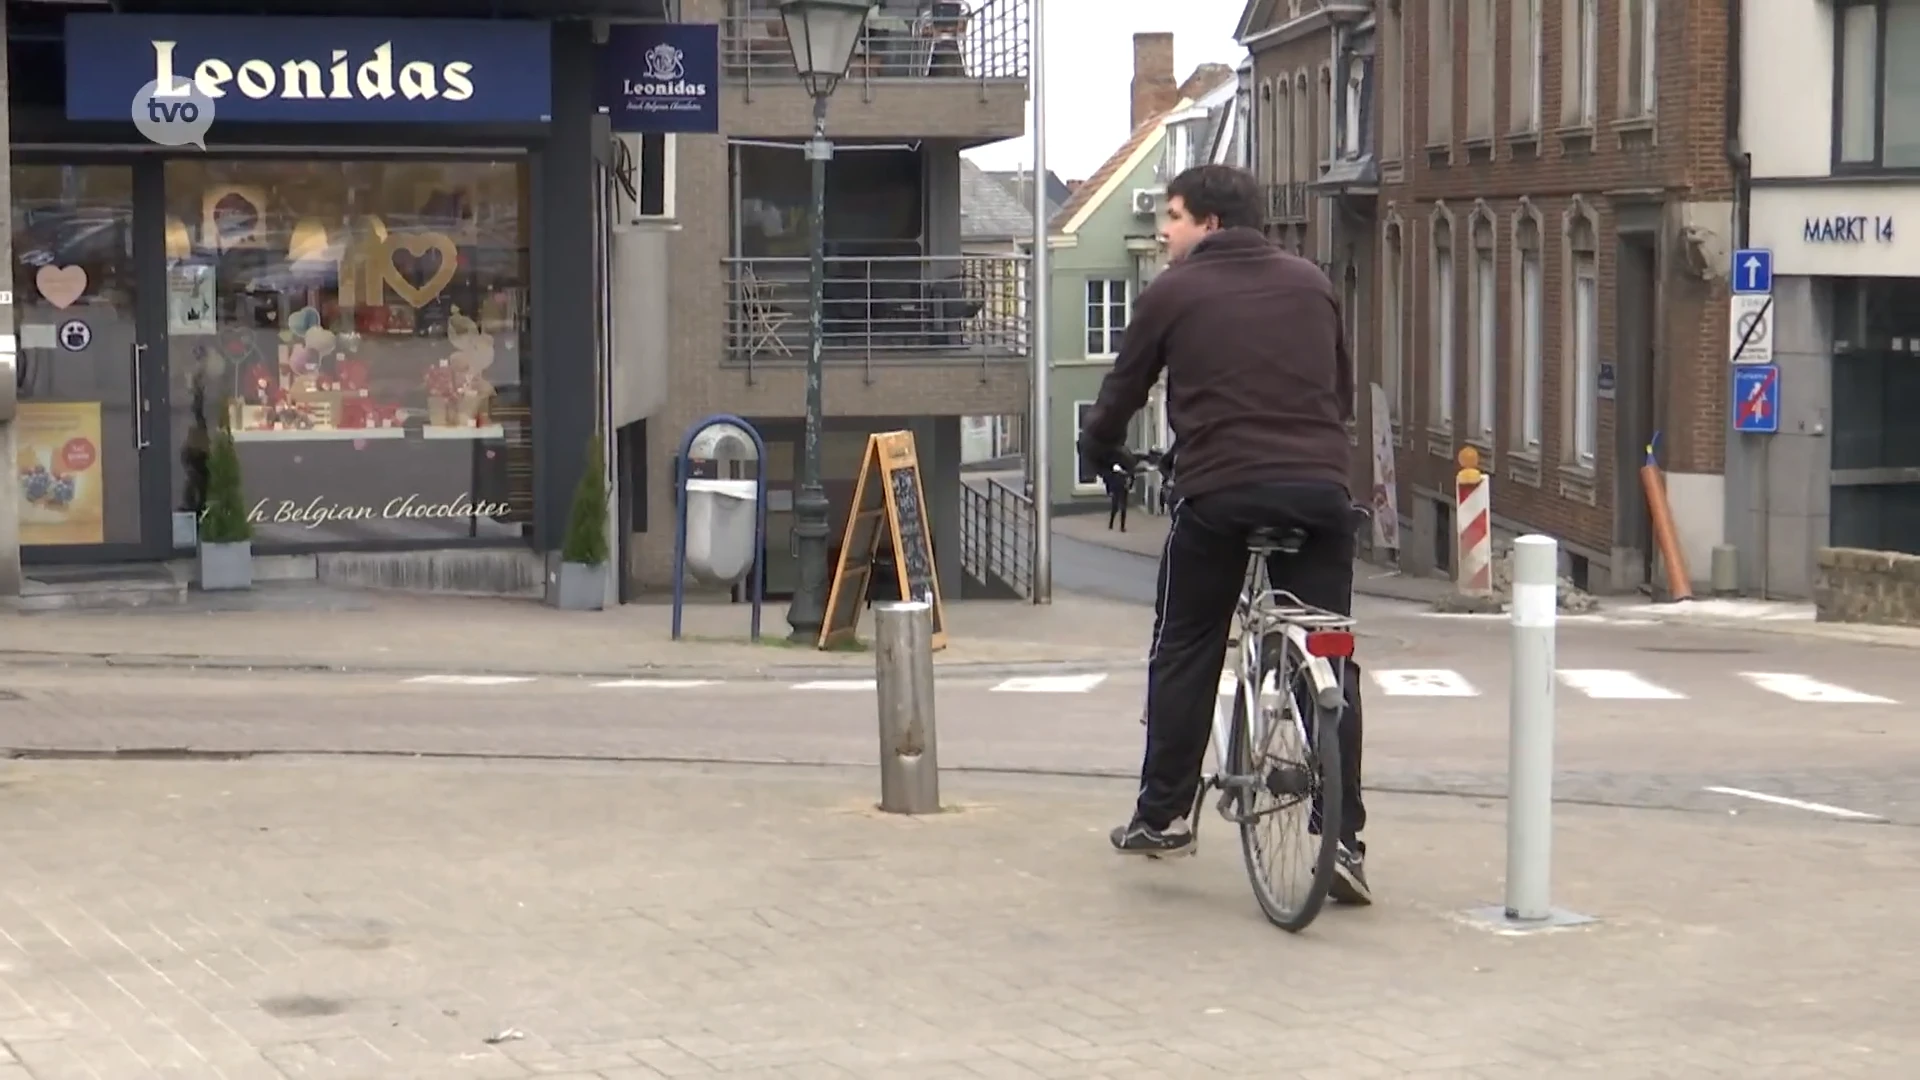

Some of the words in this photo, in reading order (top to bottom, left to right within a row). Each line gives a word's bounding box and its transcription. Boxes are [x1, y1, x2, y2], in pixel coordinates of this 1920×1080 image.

[152, 40, 474, 100] Leonidas
[624, 79, 706, 95] Leonidas
[1804, 216, 1867, 242] MARKT
[1875, 216, 1893, 242] 14
[274, 495, 377, 529] Belgian
[382, 492, 511, 519] Chocolates
